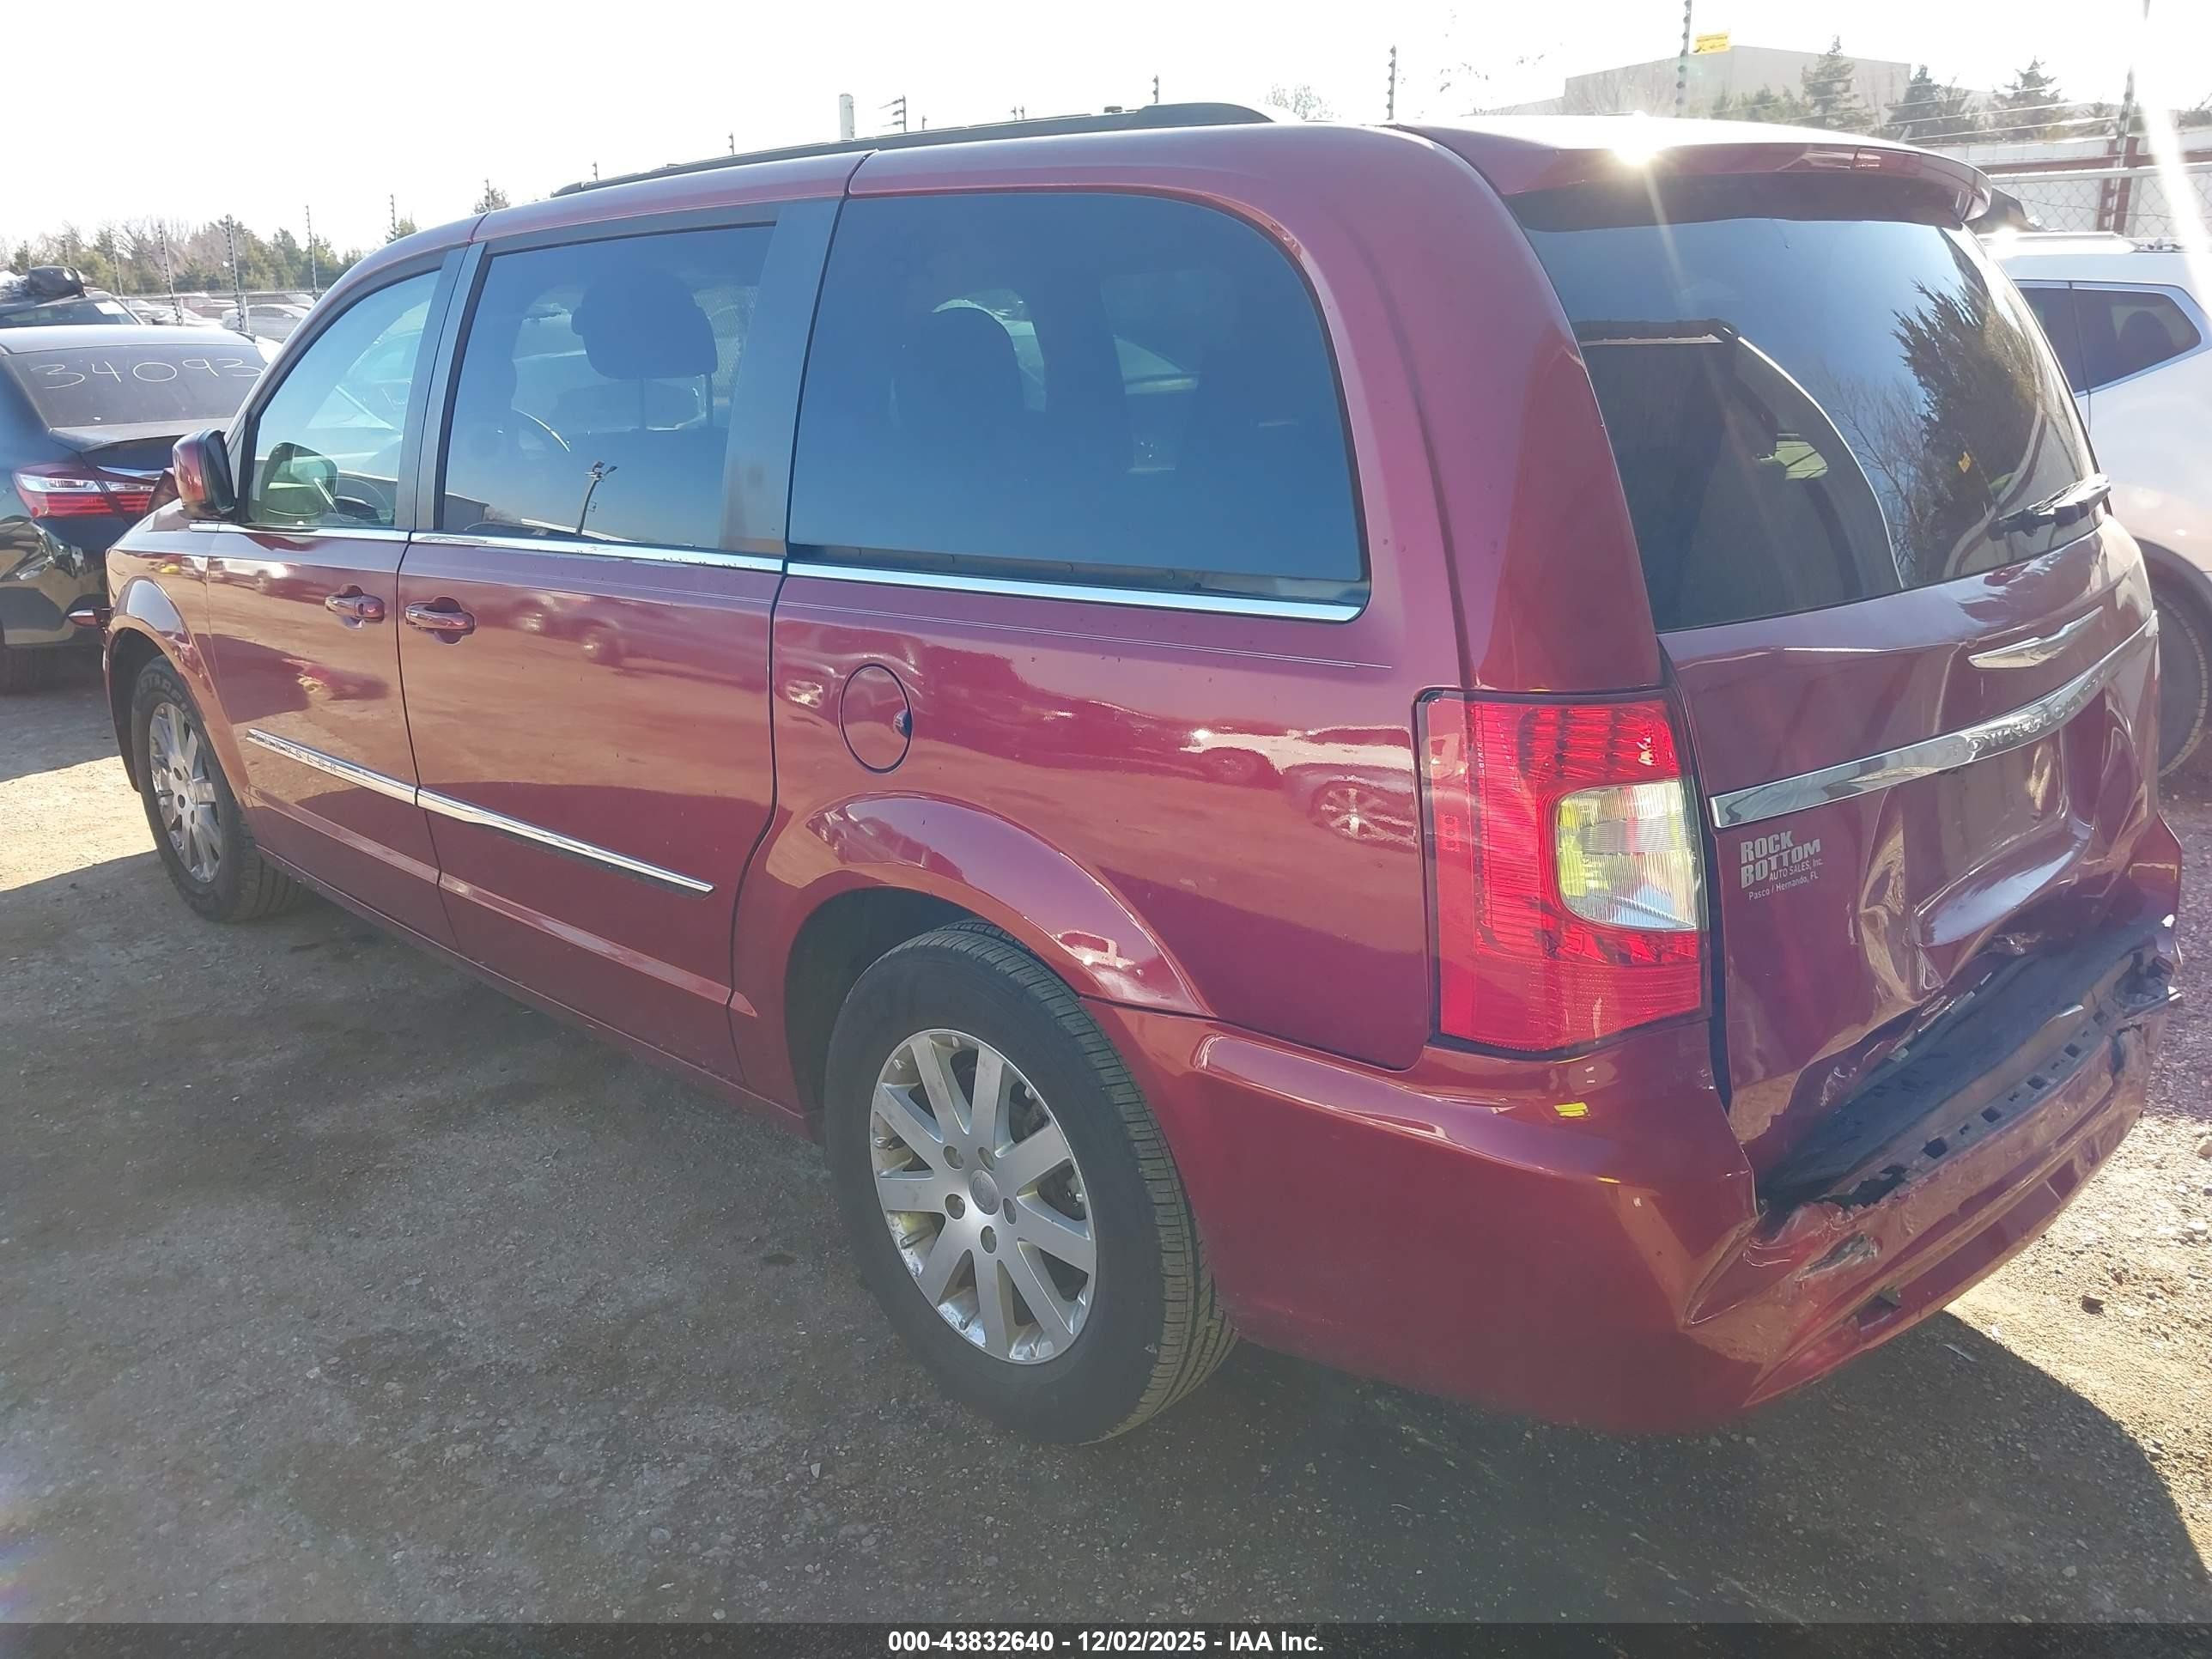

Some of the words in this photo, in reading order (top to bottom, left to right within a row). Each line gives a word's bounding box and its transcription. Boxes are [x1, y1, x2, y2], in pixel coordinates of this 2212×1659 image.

[30, 358, 263, 389] 34093
[1741, 830, 1794, 864] ROCK
[1741, 838, 1820, 889] BOTTOM
[1769, 867, 1788, 882] AUTO
[1790, 860, 1812, 875] SALES,
[1748, 888, 1770, 901] Pasco
[1810, 871, 1820, 880] FL
